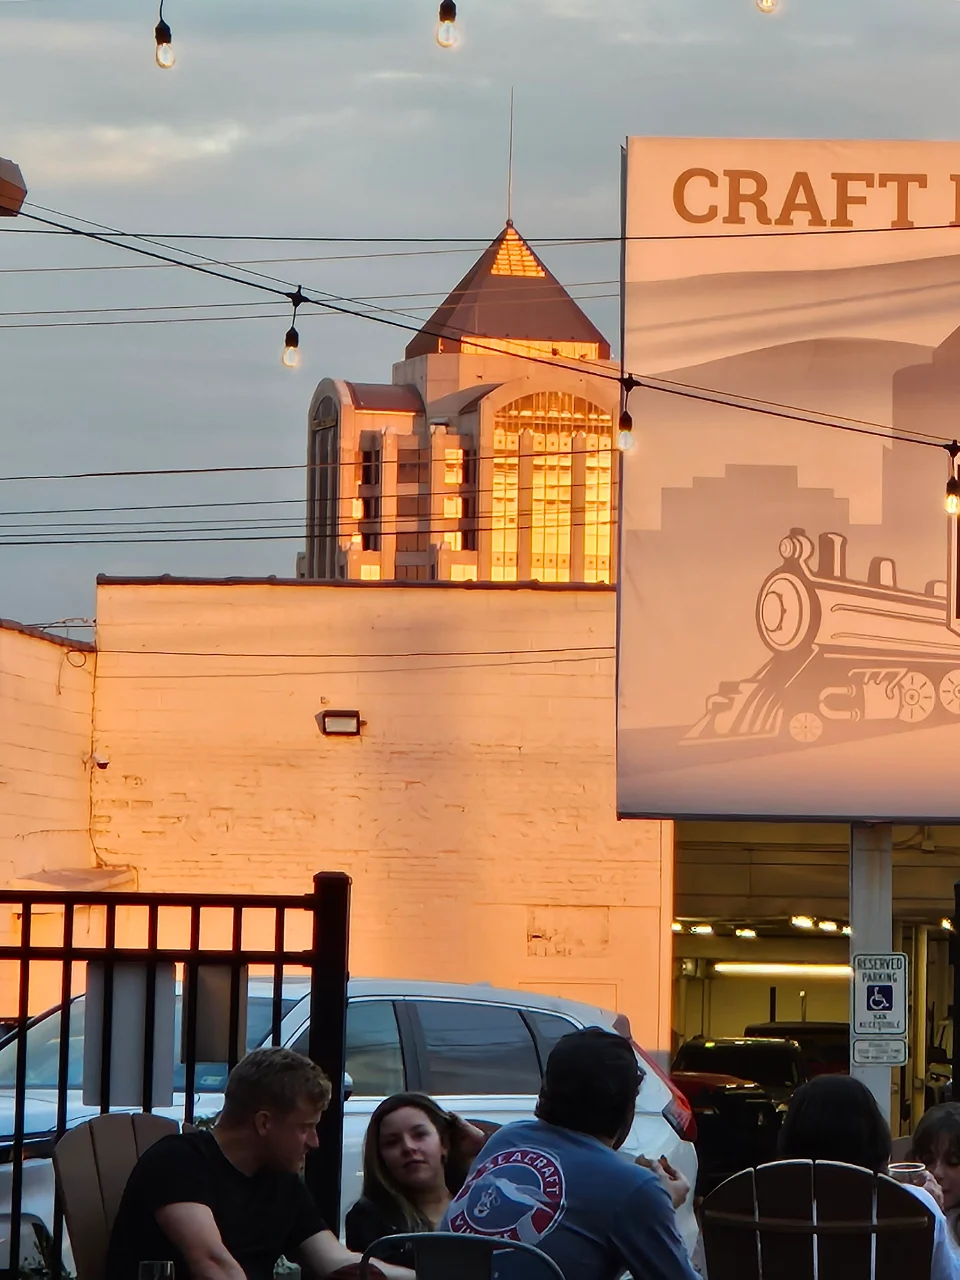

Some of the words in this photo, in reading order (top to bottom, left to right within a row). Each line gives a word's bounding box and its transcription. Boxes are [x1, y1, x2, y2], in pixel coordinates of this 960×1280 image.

[673, 168, 928, 228] CRAFT
[857, 958, 903, 970] RESERVED
[862, 971, 898, 983] PARKING
